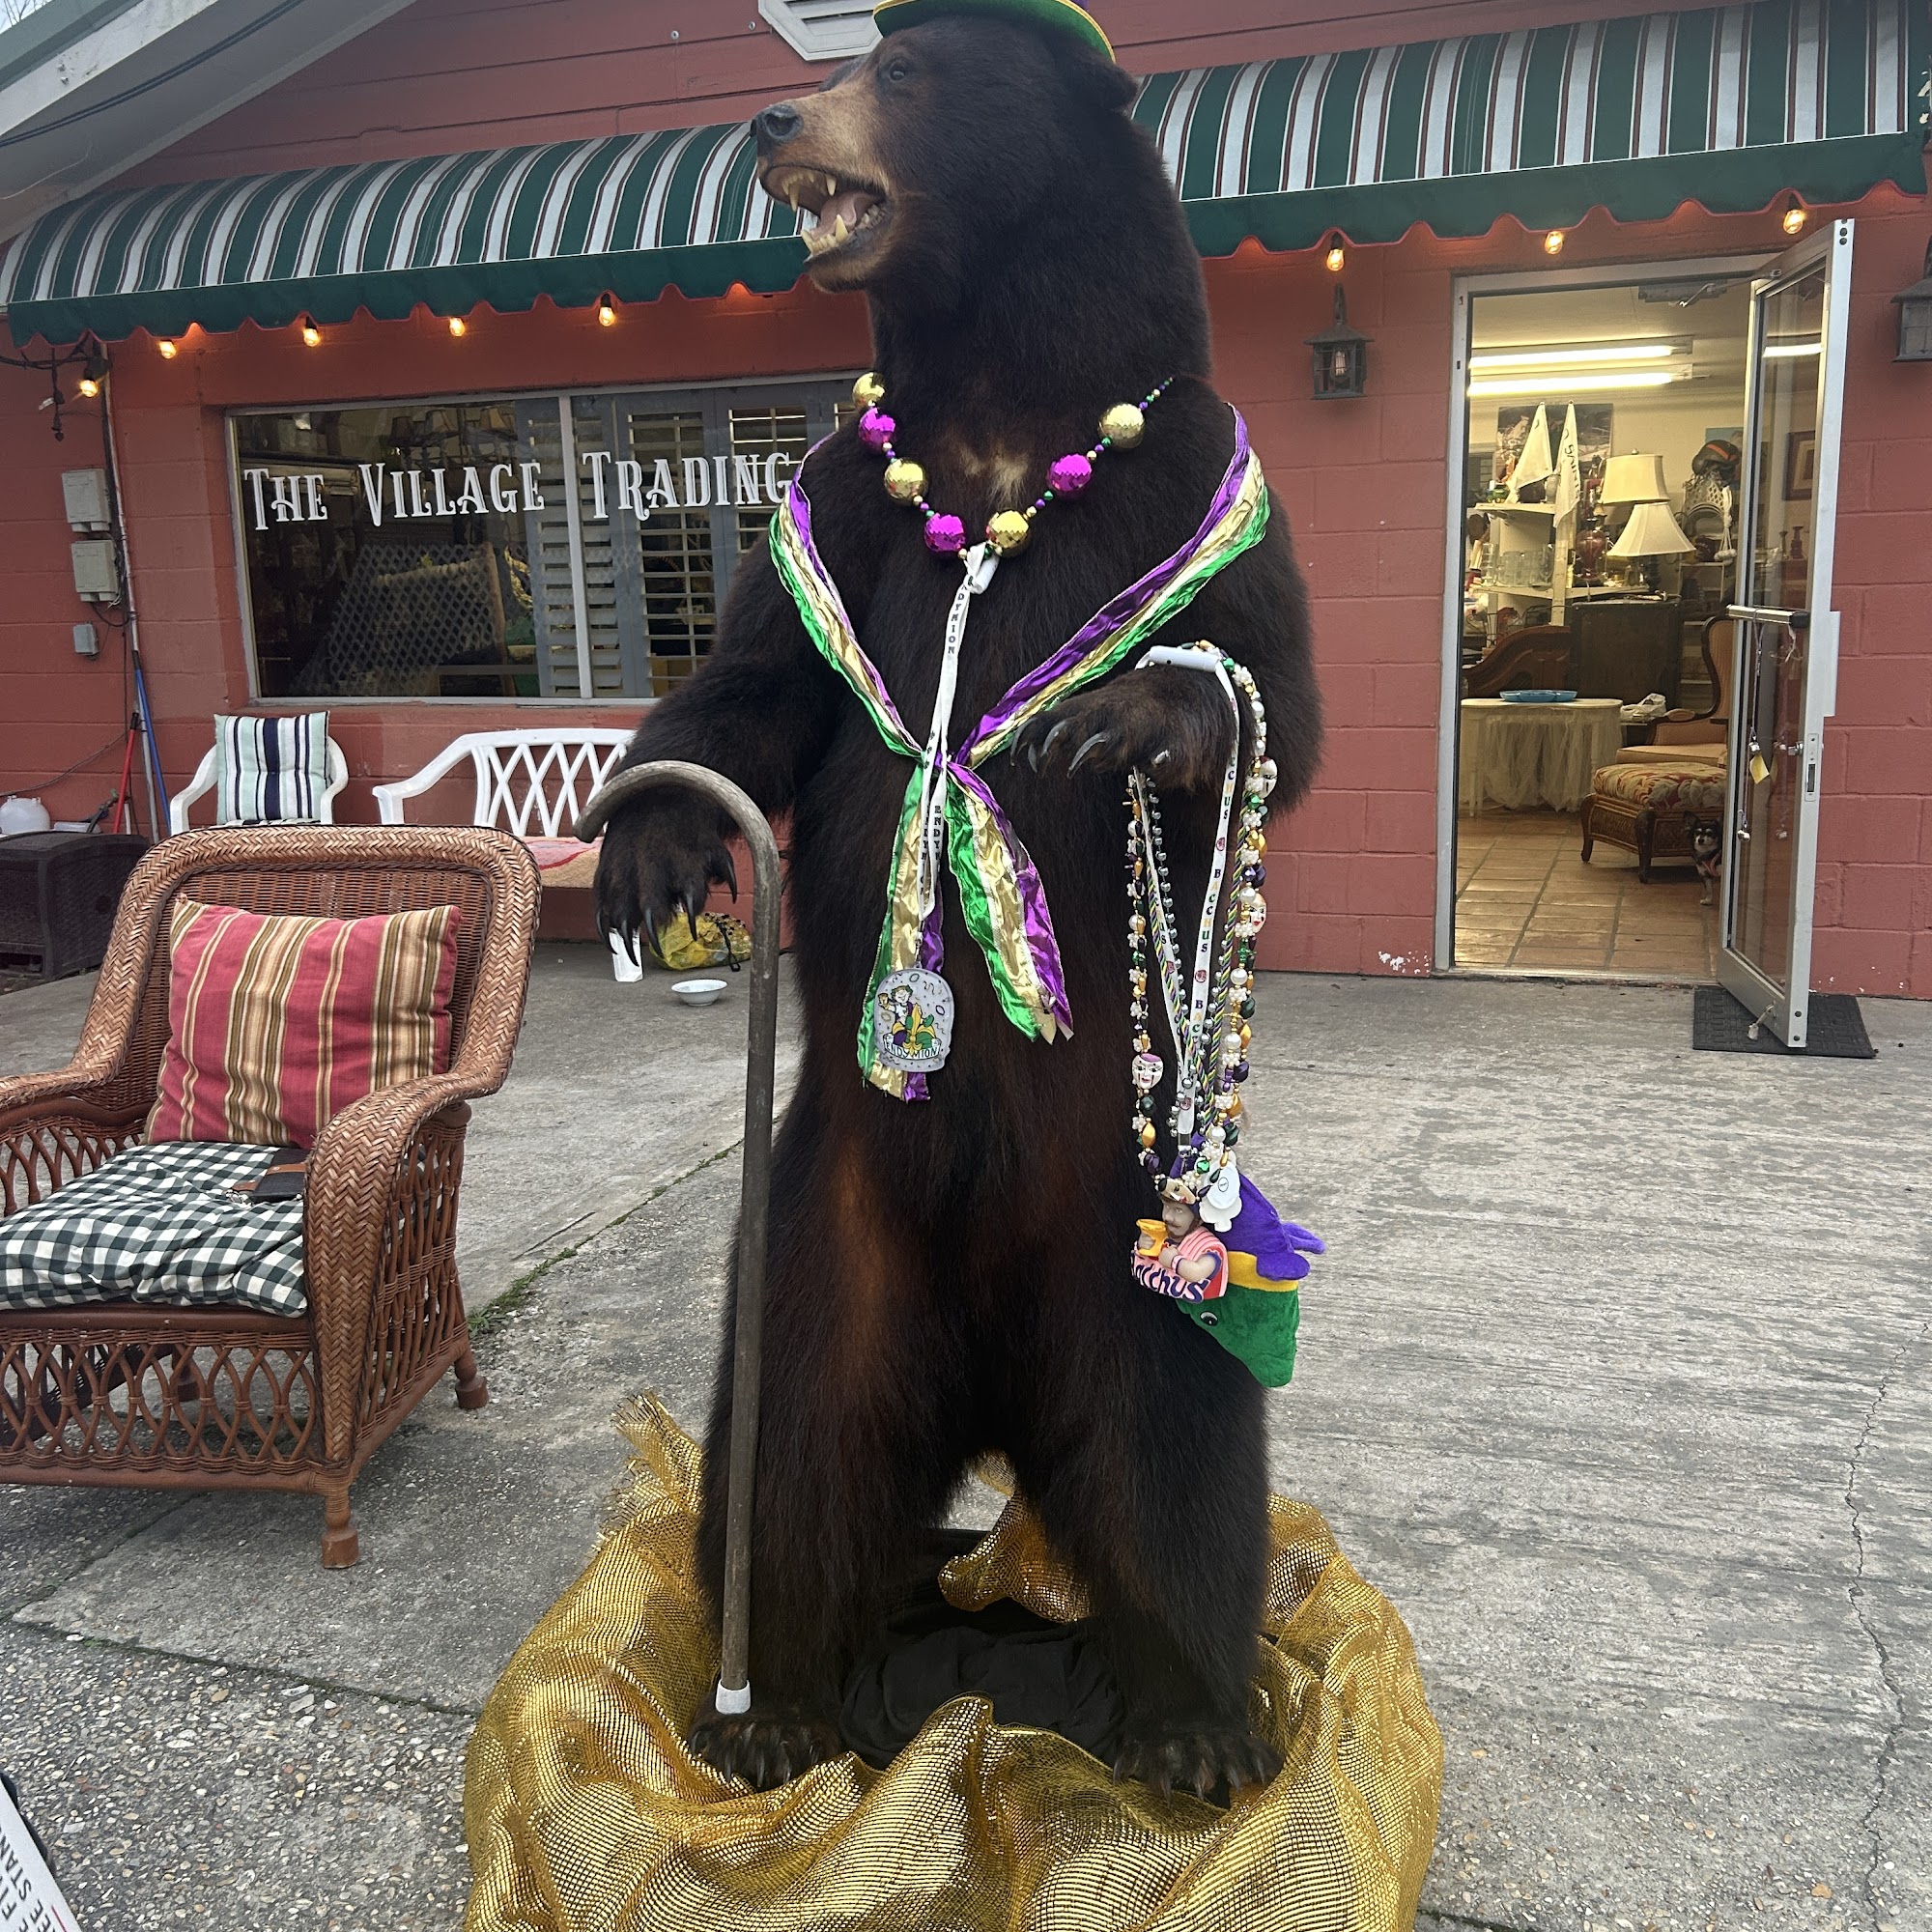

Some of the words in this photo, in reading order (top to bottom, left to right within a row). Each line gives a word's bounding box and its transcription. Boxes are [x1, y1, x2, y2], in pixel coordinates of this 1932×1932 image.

[244, 468, 328, 530] THE
[358, 462, 546, 527] VILLAGE
[582, 451, 793, 522] TRADING
[1201, 868, 1221, 953] BACCHUS
